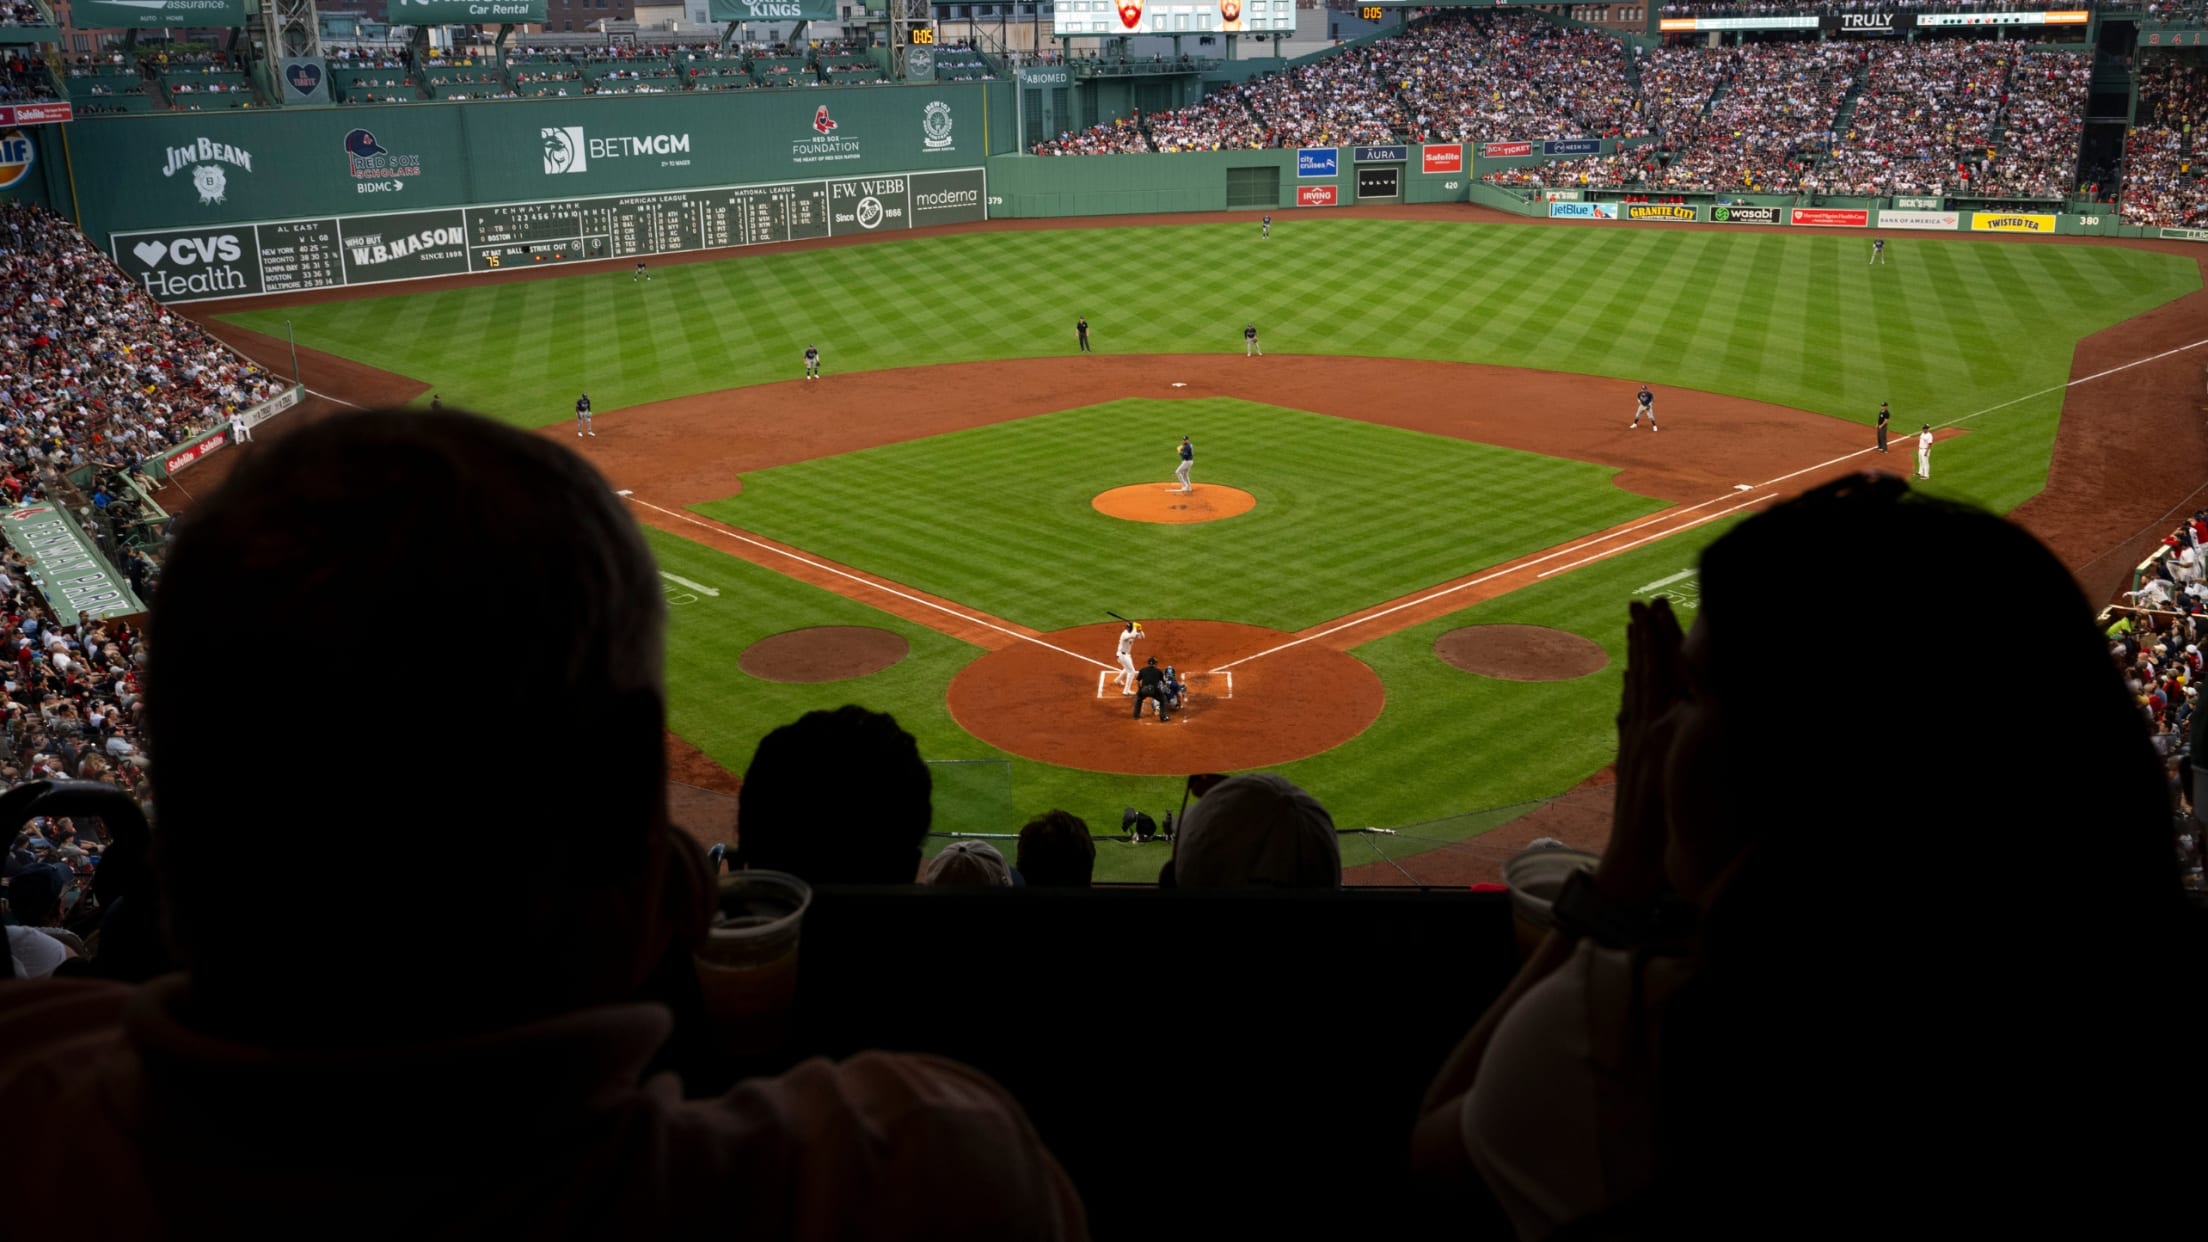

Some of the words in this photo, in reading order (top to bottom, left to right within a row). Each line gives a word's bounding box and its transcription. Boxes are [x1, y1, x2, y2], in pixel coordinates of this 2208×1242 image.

[469, 4, 489, 14] Car
[492, 4, 529, 14] Rental
[750, 4, 802, 16] KINGS
[1363, 7, 1382, 19] 0:05
[1842, 14, 1894, 26] TRULY
[912, 30, 933, 44] 0:05
[2171, 33, 2182, 46] 4
[1026, 72, 1066, 84] ABIOMED
[17, 108, 45, 120] Safelite
[792, 142, 860, 154] FOUNDATION
[1504, 144, 1530, 154] TICKET
[162, 144, 198, 177] JIM
[196, 137, 252, 173] BEAM
[355, 156, 386, 168] RED
[390, 154, 420, 168] SOX
[1300, 156, 1314, 164] city
[356, 166, 420, 179] SCHOLARS
[357, 182, 392, 193] BIDMC
[861, 178, 905, 196] WEBB
[619, 196, 657, 205] AMERICAN
[916, 189, 977, 206] moderna
[988, 196, 1002, 205] 379
[1303, 192, 1331, 200] IRVING
[550, 203, 580, 211] PARK
[1554, 204, 1588, 216] jetBlue
[1630, 206, 1672, 218] GRANITE
[1674, 206, 1696, 220] CITY
[836, 213, 854, 222] Since
[1730, 208, 1772, 219] wasabi
[1988, 216, 2022, 228] TWISTED
[2024, 218, 2040, 230] TEA
[2080, 216, 2099, 226] 380
[293, 224, 318, 232] EAST
[344, 238, 364, 247] WHO
[366, 236, 381, 245] BUT
[488, 234, 511, 242] BOSTON
[170, 234, 242, 266] CVS
[530, 244, 551, 253] STRIKE
[264, 256, 294, 264] TORONTO
[420, 252, 444, 260] SINCE
[486, 256, 500, 267] 75
[141, 264, 247, 298] Health
[266, 274, 292, 282] BOSTON
[266, 281, 301, 291] BALTIMORE
[200, 434, 223, 454] Safelite
[168, 451, 194, 472] Safelite
[18, 519, 97, 576] FENWAY
[56, 571, 130, 617] PARK
